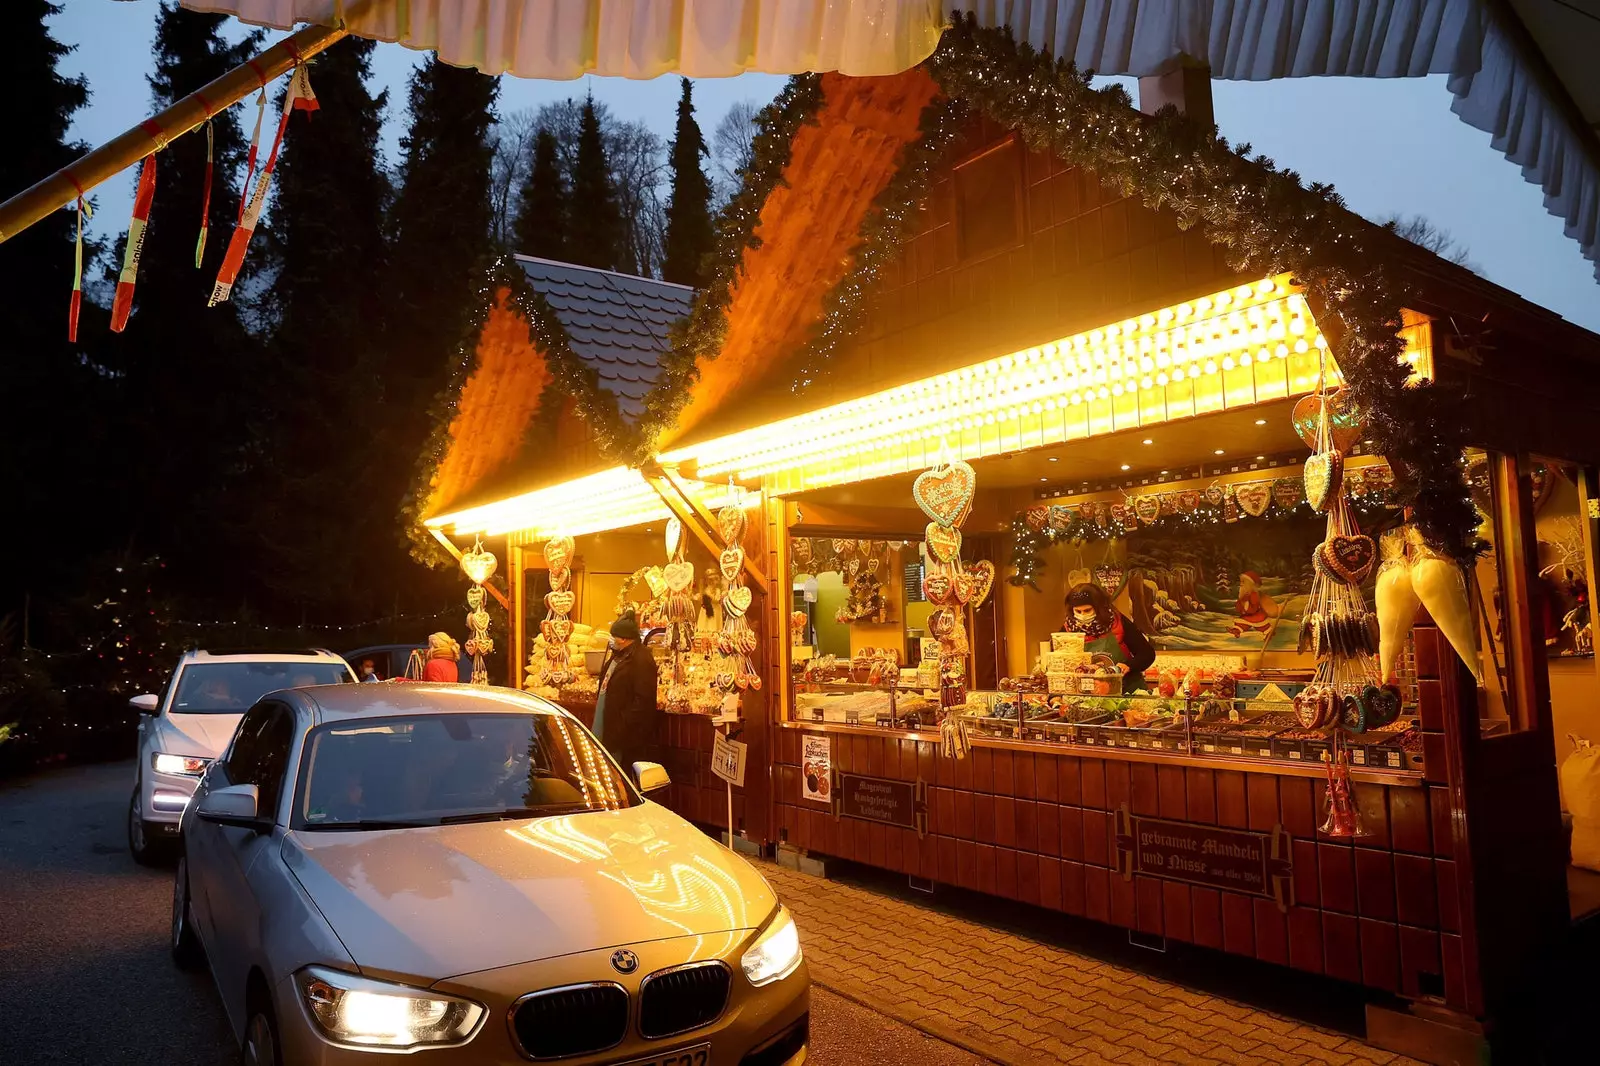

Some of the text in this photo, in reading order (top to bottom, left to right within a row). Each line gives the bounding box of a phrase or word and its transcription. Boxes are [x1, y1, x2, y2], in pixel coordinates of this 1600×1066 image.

[1140, 832, 1260, 861] gebrannte Mandeln
[1143, 851, 1164, 865] und
